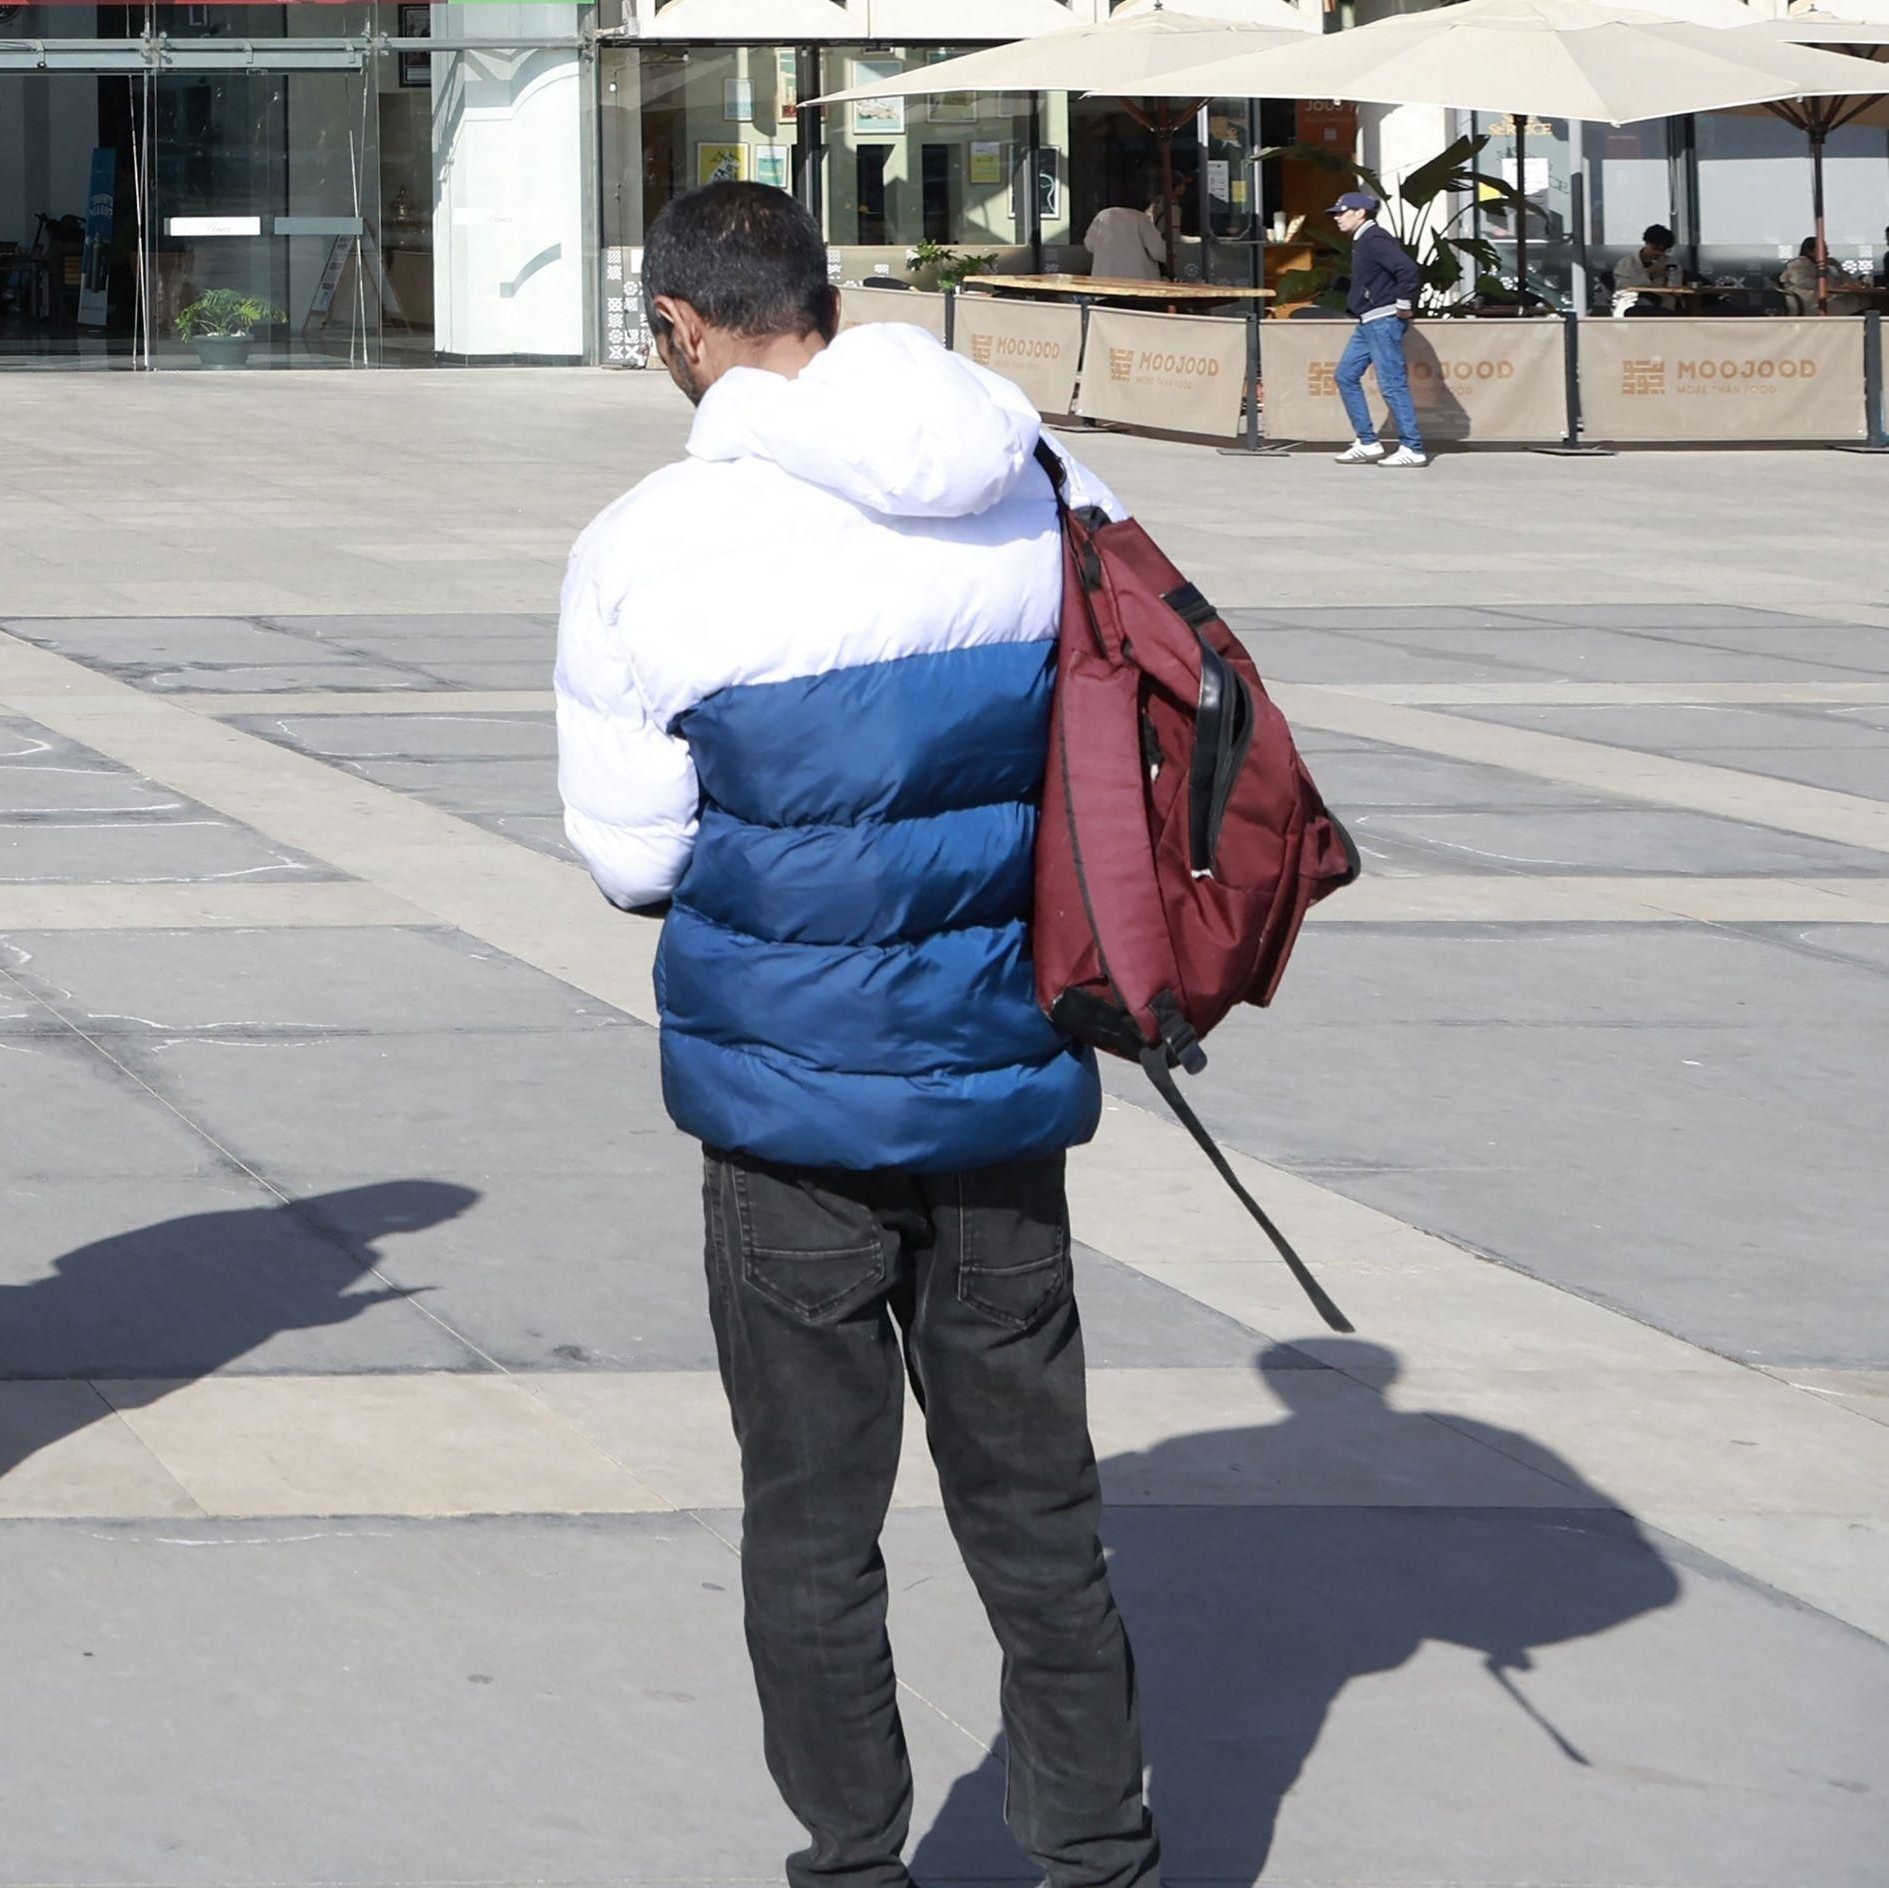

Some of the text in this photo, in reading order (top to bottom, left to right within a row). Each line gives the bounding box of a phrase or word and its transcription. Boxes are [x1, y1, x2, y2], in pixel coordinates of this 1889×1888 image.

[997, 337, 1060, 360] MOOJOOD
[1139, 351, 1219, 377] MOOJOOD
[1678, 359, 1817, 379] MOOJOOD
[1677, 385, 1777, 395] MORE THAN FOOD
